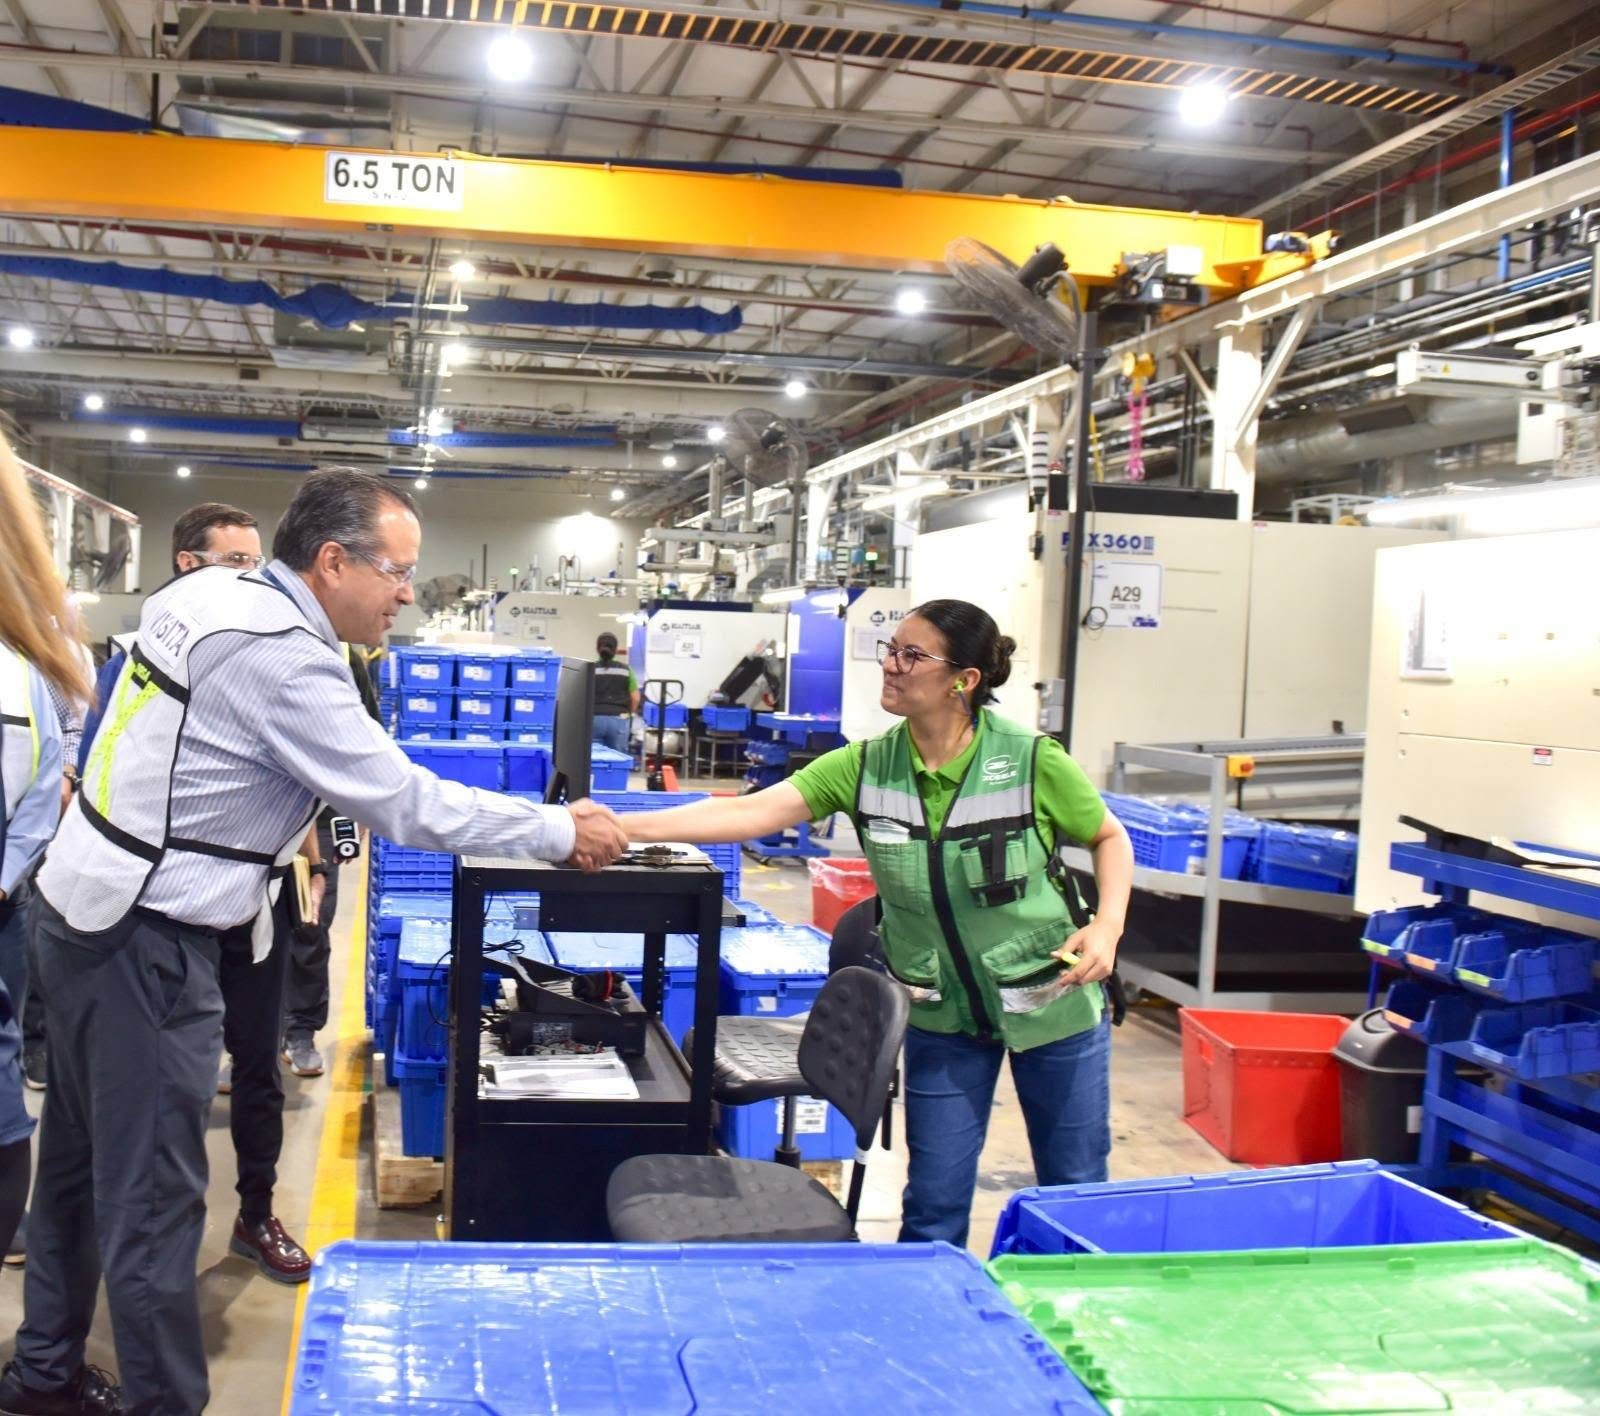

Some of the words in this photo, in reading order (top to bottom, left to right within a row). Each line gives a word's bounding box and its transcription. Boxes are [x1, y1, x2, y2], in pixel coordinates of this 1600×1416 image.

[334, 158, 379, 189] 6.5
[392, 162, 455, 194] TON
[1111, 585, 1142, 602] A29
[150, 610, 191, 657] VISITA
